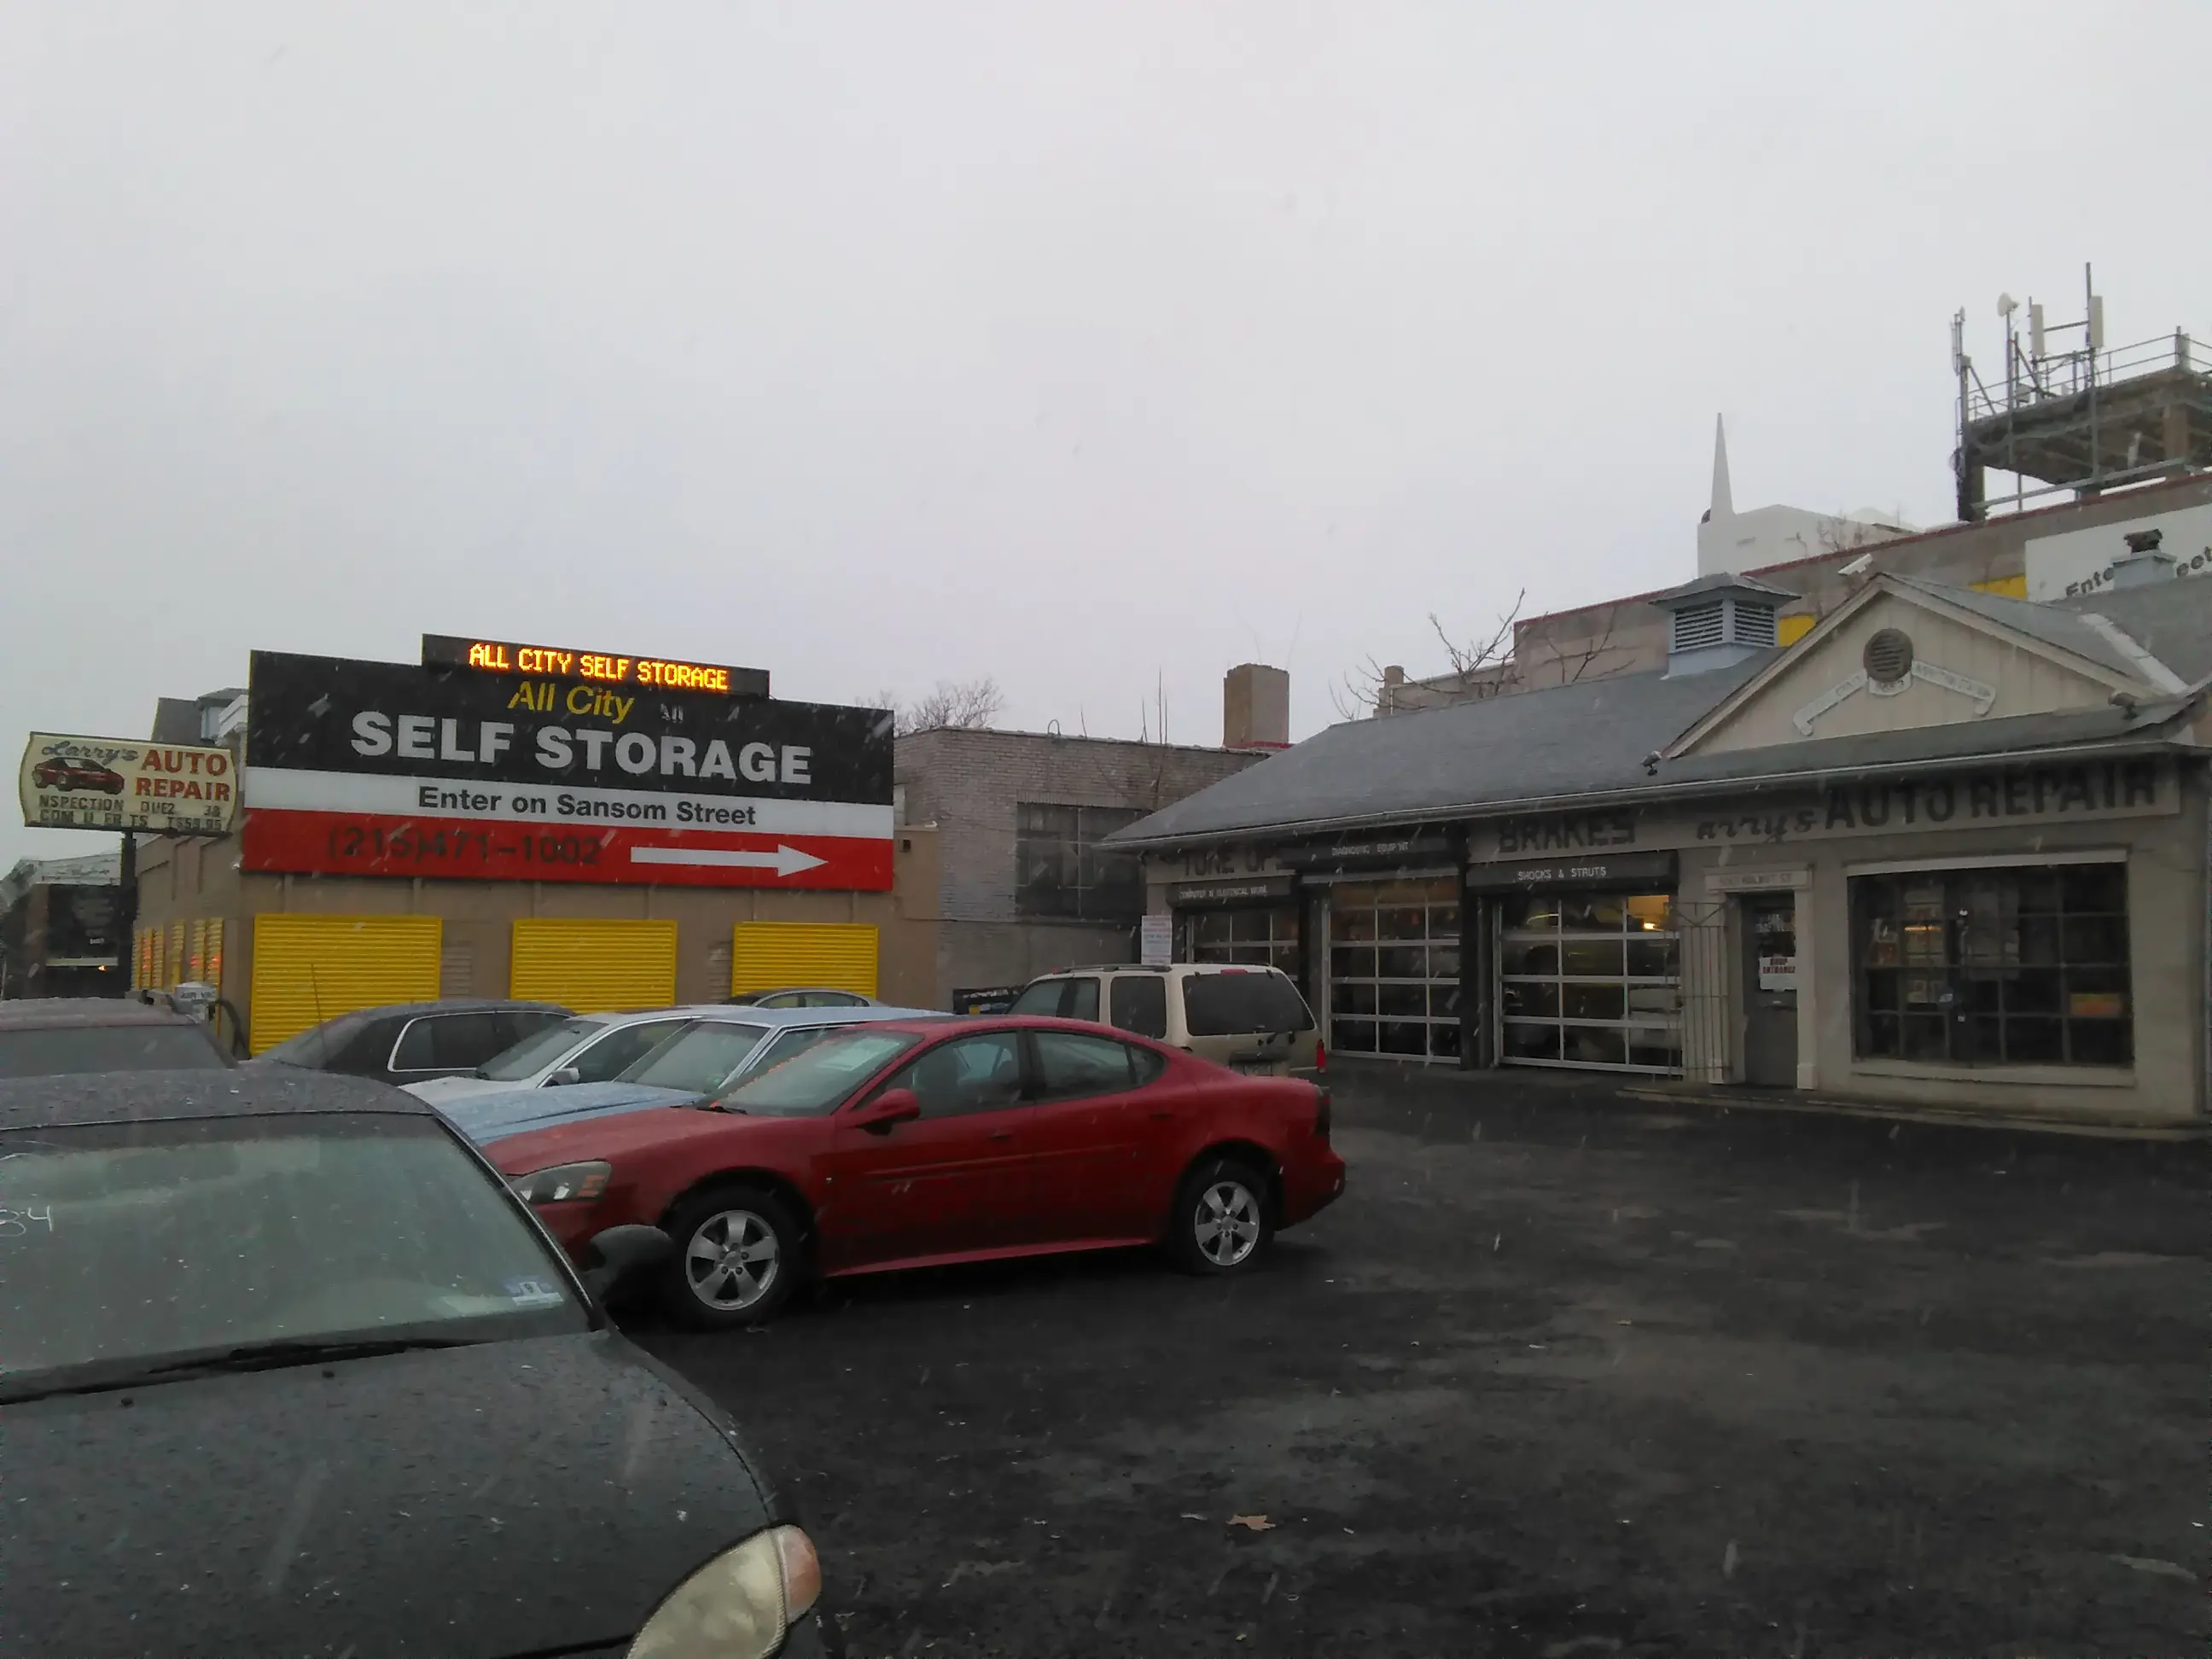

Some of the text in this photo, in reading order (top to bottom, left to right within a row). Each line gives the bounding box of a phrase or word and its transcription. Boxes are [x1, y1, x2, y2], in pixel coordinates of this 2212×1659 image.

[469, 643, 730, 690] ALL CITY SELF STORAGE
[507, 680, 635, 725] All City
[41, 740, 227, 777] Larry's AUTO
[351, 711, 813, 784] SELF STORAGE
[136, 777, 230, 801] REPAIR
[418, 785, 756, 826] Enter on Sansom Street
[1825, 775, 1955, 828] AUTO
[1970, 760, 2157, 818] REPAIR
[1499, 811, 1636, 853] BRAKES
[1517, 869, 1552, 881] SHOCKS
[1571, 867, 1608, 878] STRUTS
